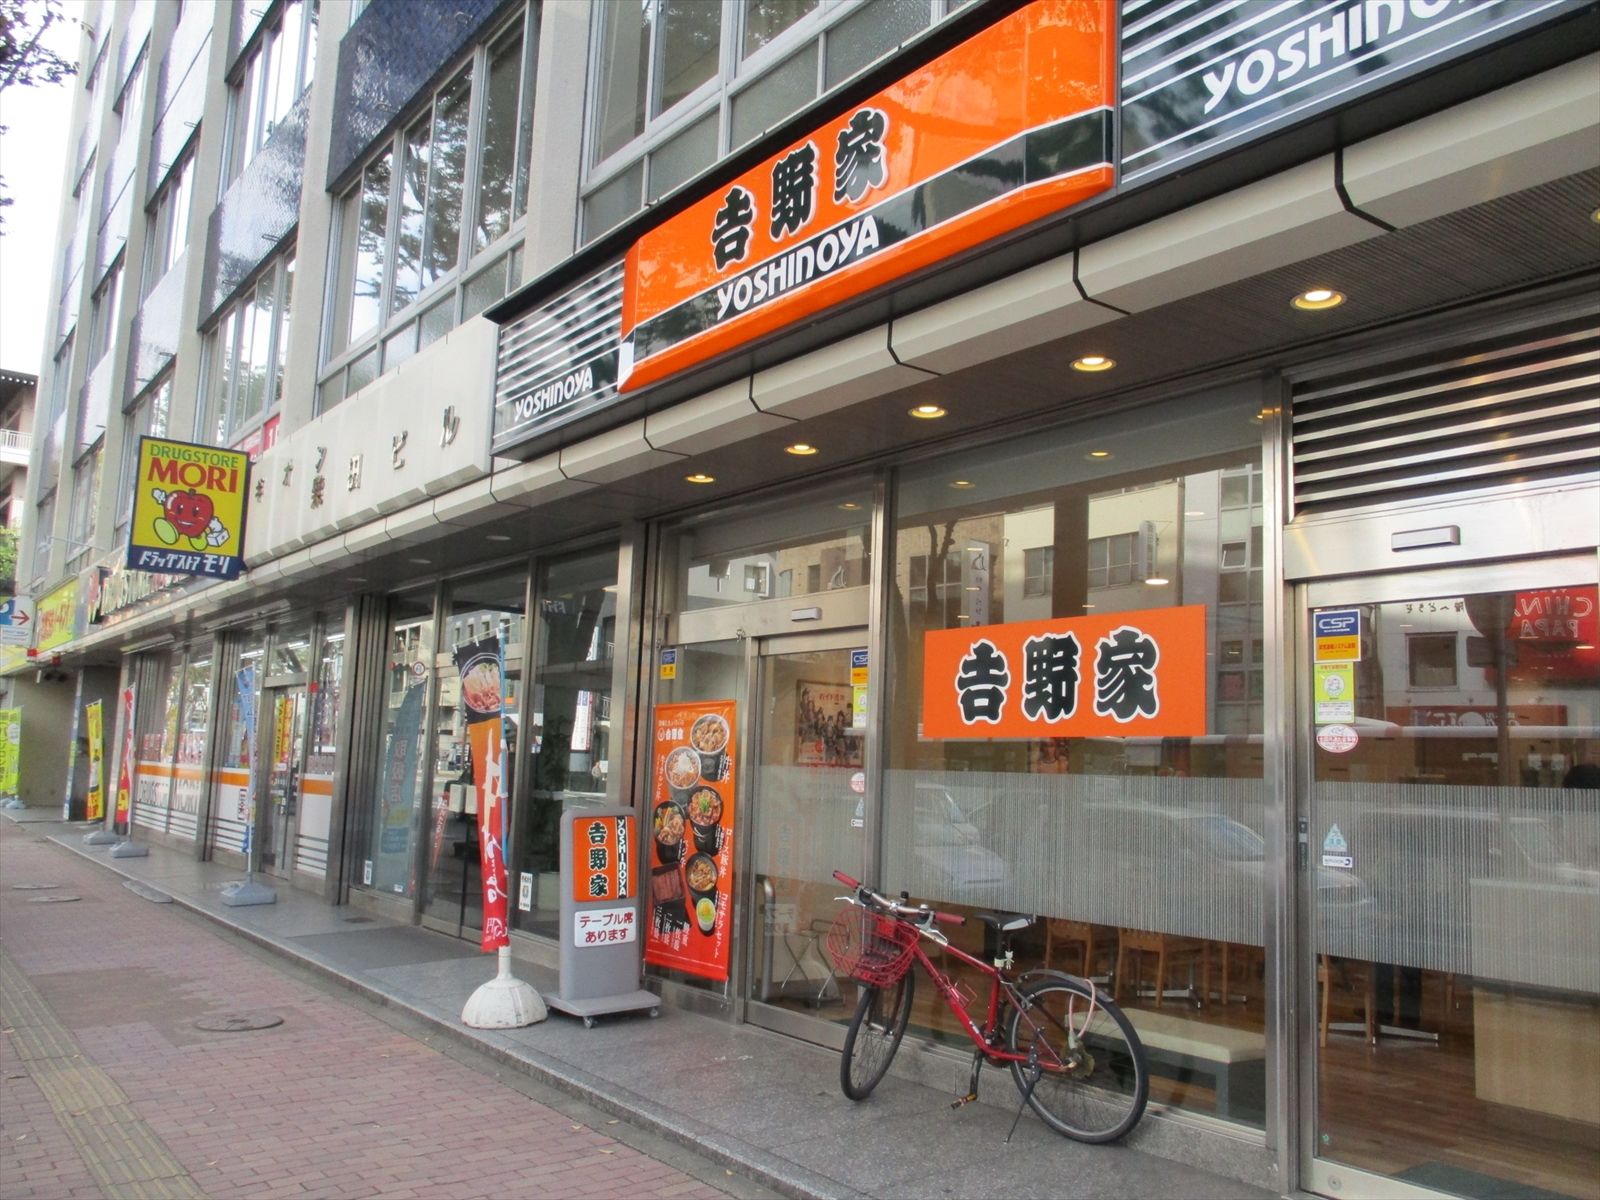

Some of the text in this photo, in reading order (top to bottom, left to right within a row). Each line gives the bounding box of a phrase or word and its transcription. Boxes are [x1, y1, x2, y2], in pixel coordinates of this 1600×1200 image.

[711, 107, 890, 274] 吉野家
[717, 214, 880, 320] YOSHINOYA
[514, 366, 593, 422] YOSHINOYA
[147, 457, 239, 493] MORI
[150, 443, 239, 468] DRUGSTORE
[1318, 616, 1356, 630] CSP
[955, 625, 1160, 725] 吉野家
[588, 821, 609, 898] 吉野家
[617, 818, 627, 895] YOSHINOYA
[579, 912, 633, 929] テーブル席
[584, 927, 630, 944] あります
